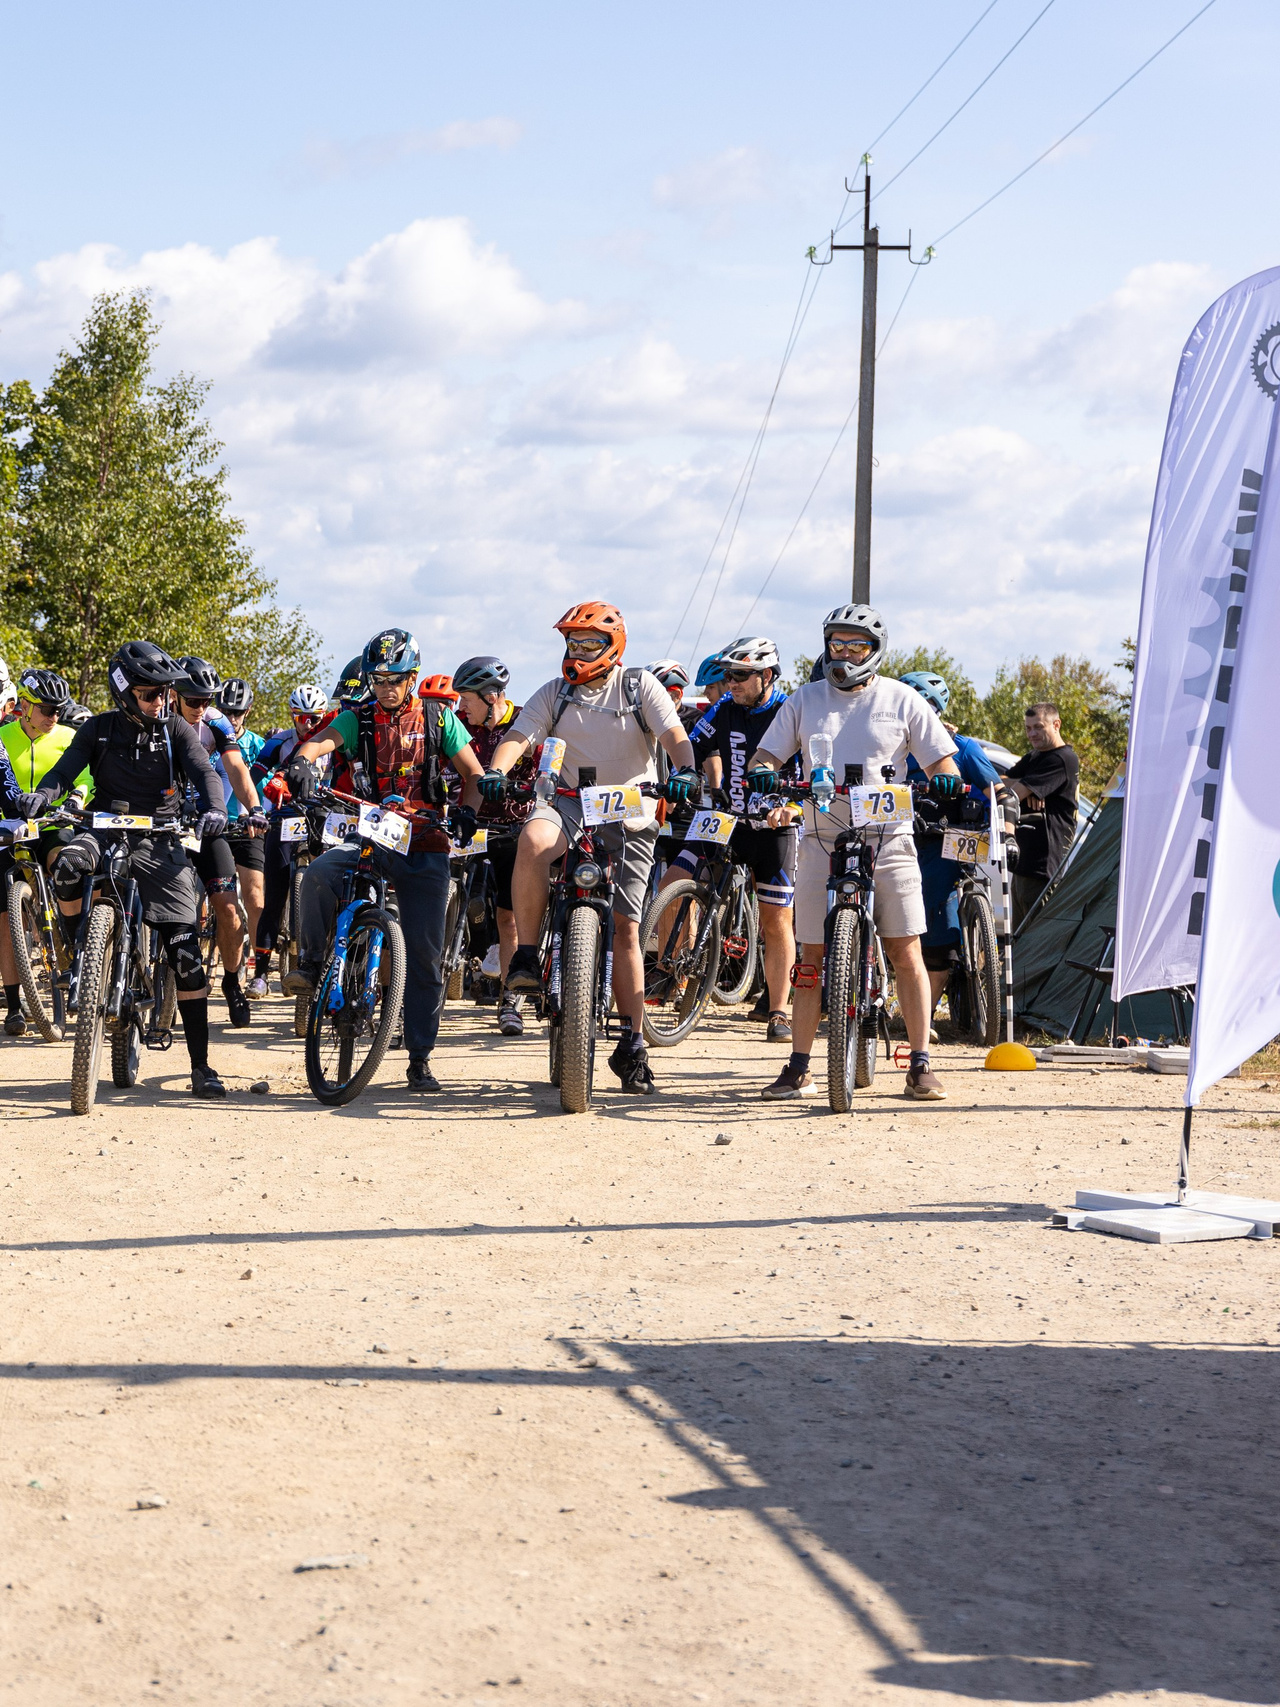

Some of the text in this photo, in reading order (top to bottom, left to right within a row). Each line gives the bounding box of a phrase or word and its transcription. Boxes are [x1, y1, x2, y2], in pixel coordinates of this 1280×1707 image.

[729, 731, 747, 813] scovery
[598, 790, 626, 814] 72
[868, 791, 895, 815] 73
[110, 816, 135, 826] 69
[700, 817, 721, 834] 93
[957, 837, 977, 855] 98
[169, 932, 193, 945] LEATT
